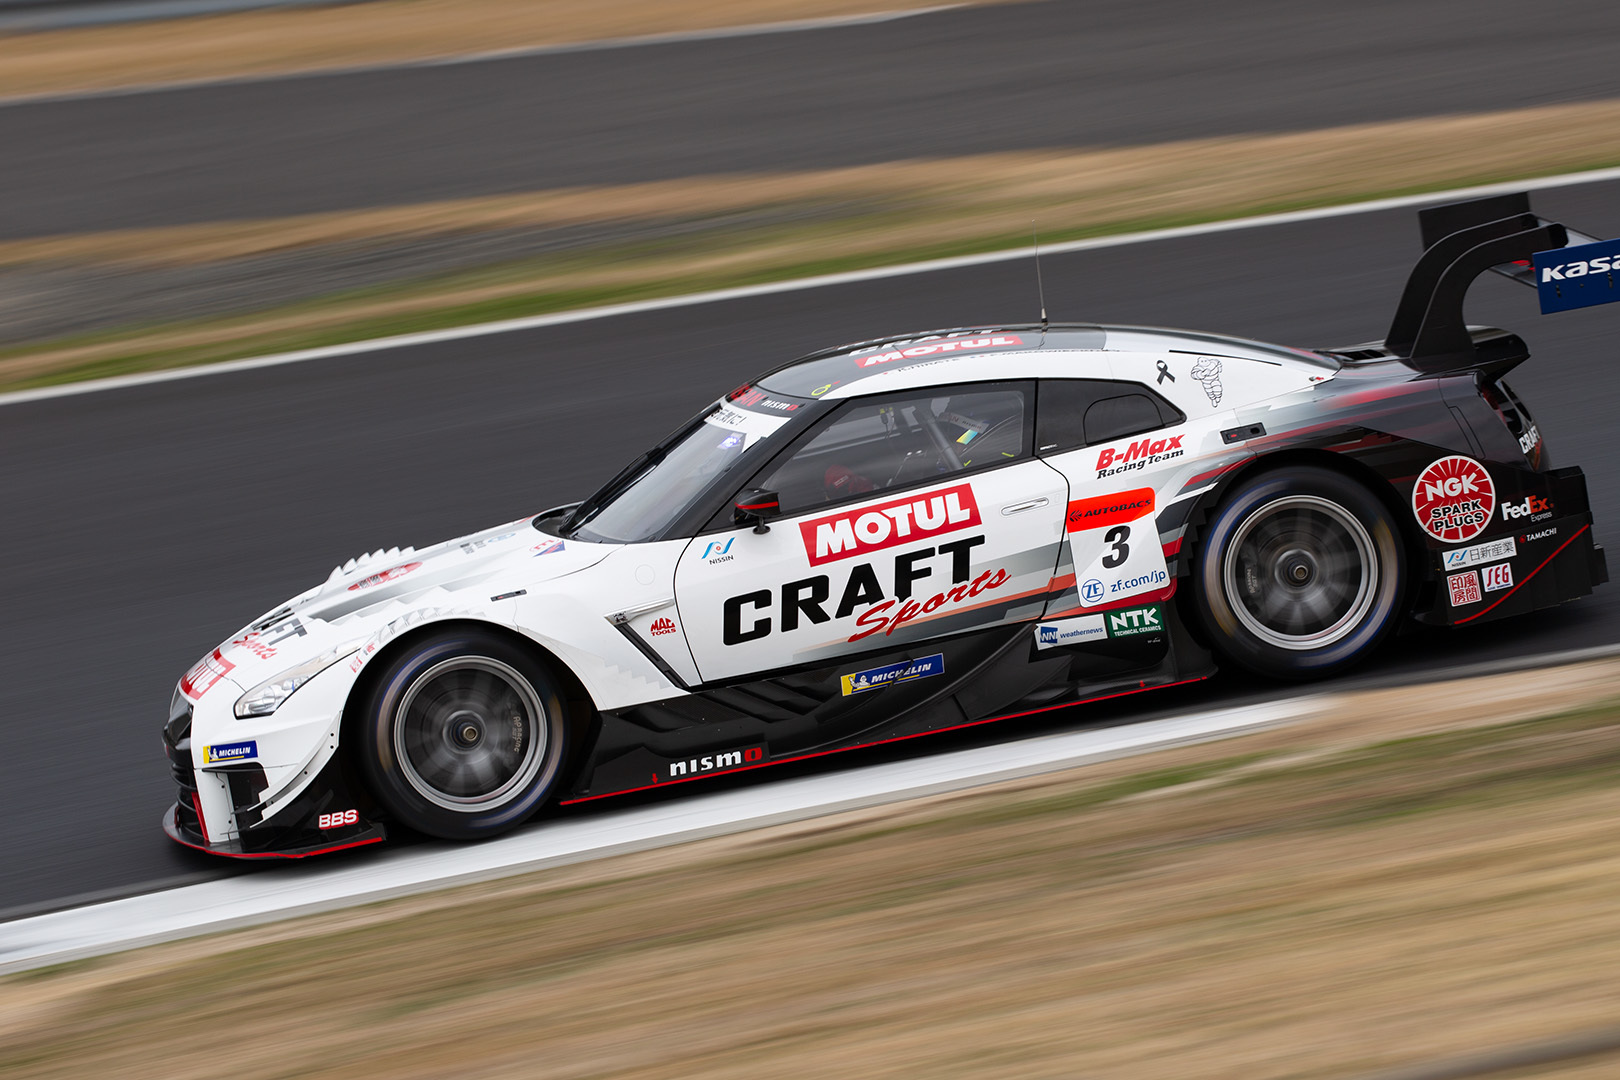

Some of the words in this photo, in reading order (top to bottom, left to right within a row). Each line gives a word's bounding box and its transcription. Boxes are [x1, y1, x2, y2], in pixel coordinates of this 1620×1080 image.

[863, 336, 1014, 366] MOTUL
[761, 399, 799, 412] nismo
[1095, 434, 1185, 471] B-Max
[1097, 459, 1146, 479] Racing
[1148, 449, 1184, 464] Team
[1424, 472, 1479, 502] NGK
[1084, 499, 1152, 518] AUTOBACS
[1431, 498, 1481, 519] SPARK
[1501, 495, 1549, 521] FedEx
[1530, 511, 1552, 522] Express
[816, 492, 970, 558] MOTUL
[1433, 511, 1484, 532] PLUGS
[1526, 527, 1557, 542] TAMACHI
[1102, 525, 1131, 569] 3
[1470, 541, 1514, 561] 日新産業
[709, 555, 734, 565] NISSIN
[723, 534, 985, 646] CRAFT
[1082, 580, 1104, 600] ZF
[1111, 570, 1166, 593] zf.com/jp
[847, 568, 1012, 643] Sports
[650, 617, 676, 632] MAC
[1110, 607, 1159, 631] NTK
[651, 628, 676, 636] TOOLS
[1060, 627, 1104, 639] weathernews
[1114, 629, 1139, 637] TECHNICAL
[1139, 625, 1161, 633] CERAMICS
[219, 746, 251, 757] MICHELIN
[670, 747, 763, 777] nismo
[319, 809, 359, 830] BBS
